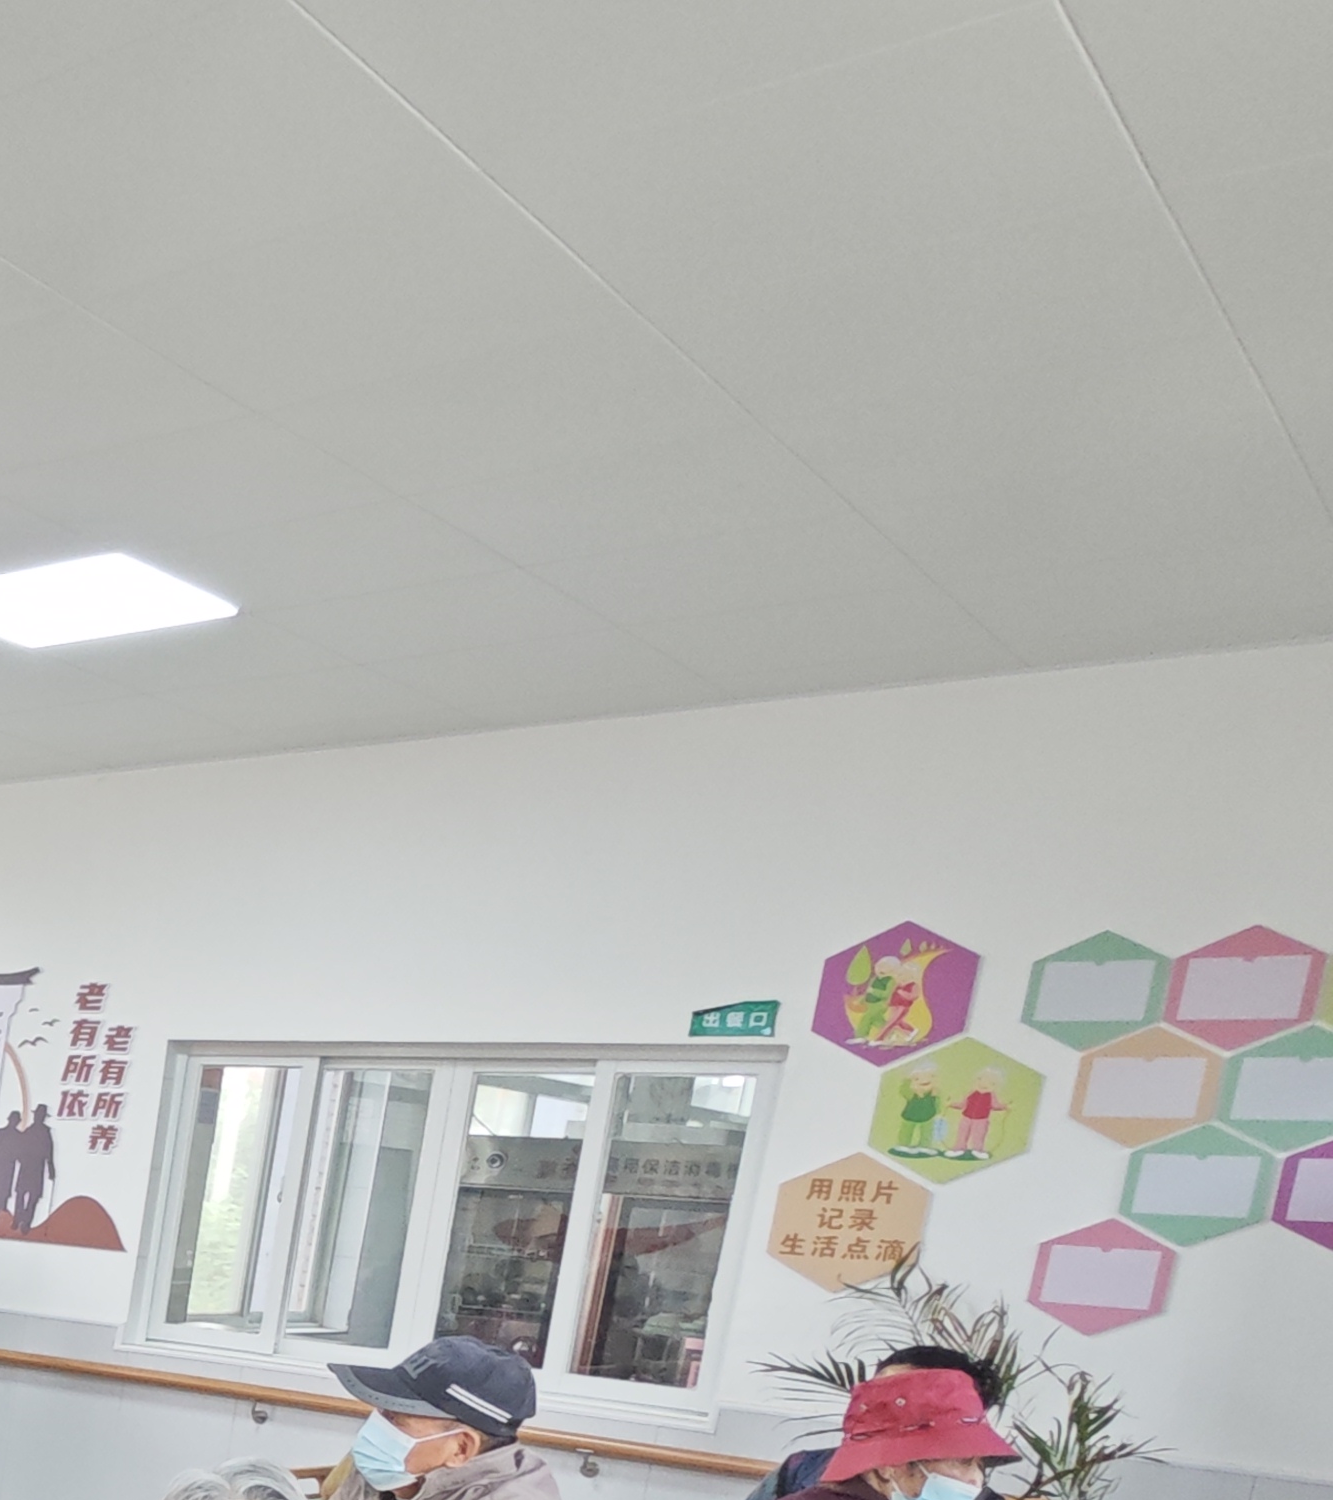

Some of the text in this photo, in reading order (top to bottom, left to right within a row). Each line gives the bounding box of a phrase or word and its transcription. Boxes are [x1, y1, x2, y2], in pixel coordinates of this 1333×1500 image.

[701, 1010, 769, 1028] 出餐口
[56, 982, 108, 1120] 老有所依
[87, 1025, 134, 1153] 老有所养
[805, 1177, 900, 1206] 用照片
[816, 1207, 879, 1232] 记录
[777, 1232, 907, 1263] 生活点滴
